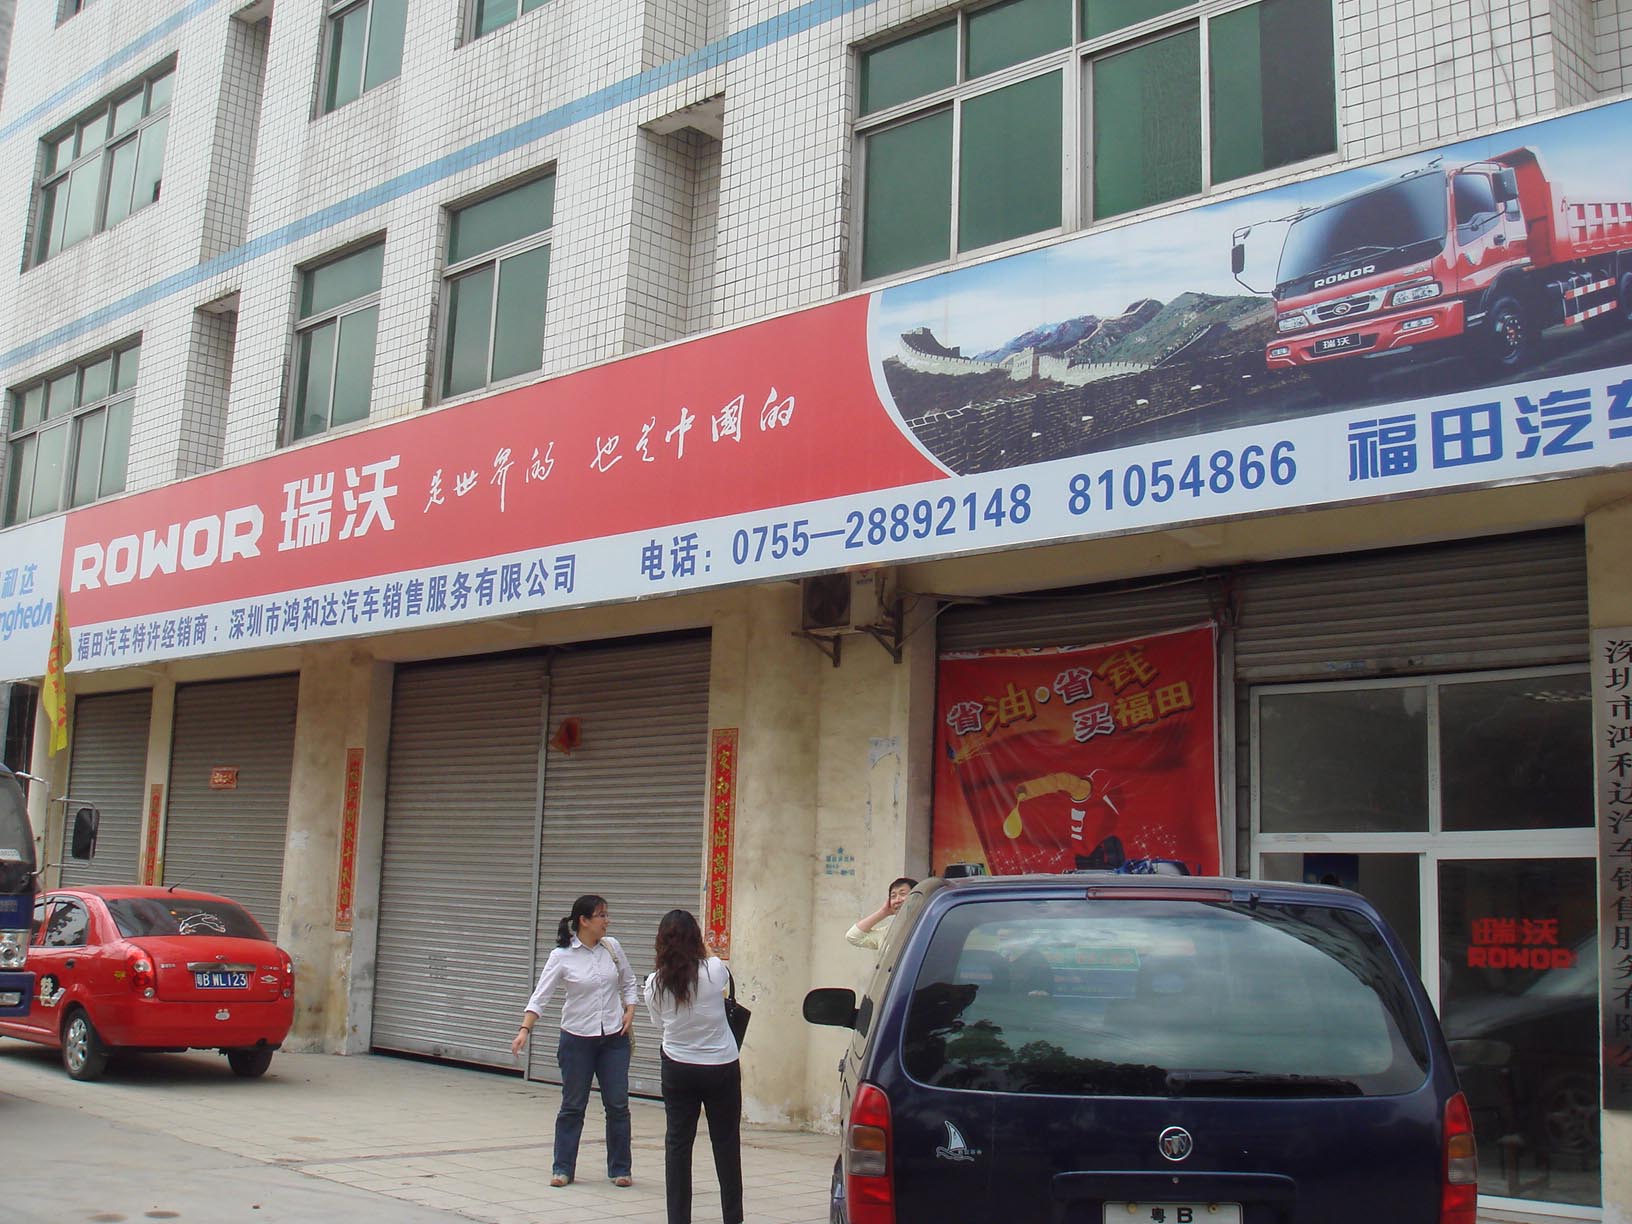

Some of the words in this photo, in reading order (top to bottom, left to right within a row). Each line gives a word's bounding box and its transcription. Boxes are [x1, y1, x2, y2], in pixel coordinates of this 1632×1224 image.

[1314, 264, 1376, 289] ROWOR
[70, 504, 265, 594] ROWOR
[278, 454, 402, 555] 瑞沃
[229, 553, 577, 640] 深圳市鸿和达汽车销售服务有限公司
[1067, 439, 1298, 516] 81054866
[0, 563, 38, 599] 和达
[1072, 681, 1196, 743] 买福田
[1472, 917, 1559, 945] 瑞沃
